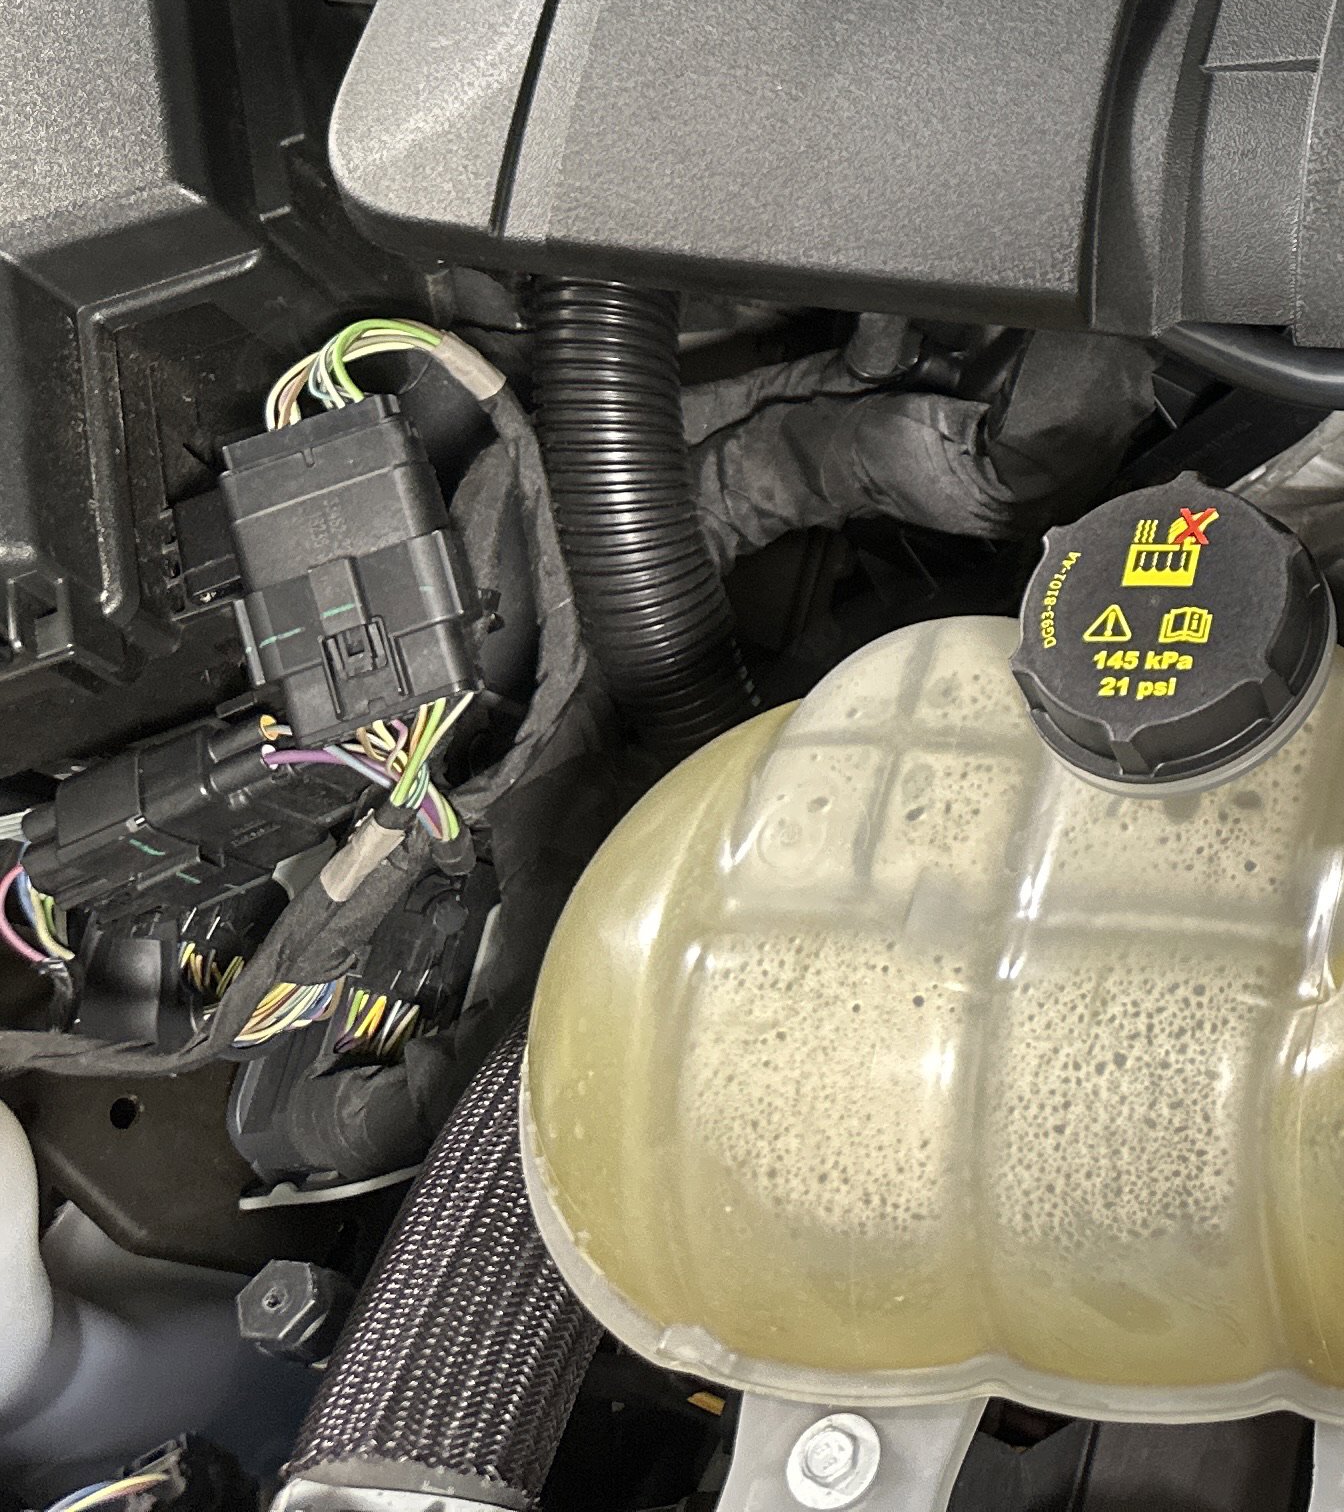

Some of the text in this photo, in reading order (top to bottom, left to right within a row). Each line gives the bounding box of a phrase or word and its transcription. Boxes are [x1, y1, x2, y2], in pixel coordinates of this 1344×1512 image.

[1040, 551, 1082, 649] DG93-8101-AA
[1092, 650, 1194, 670] 145 kPa
[1097, 676, 1177, 700] 21 psi
